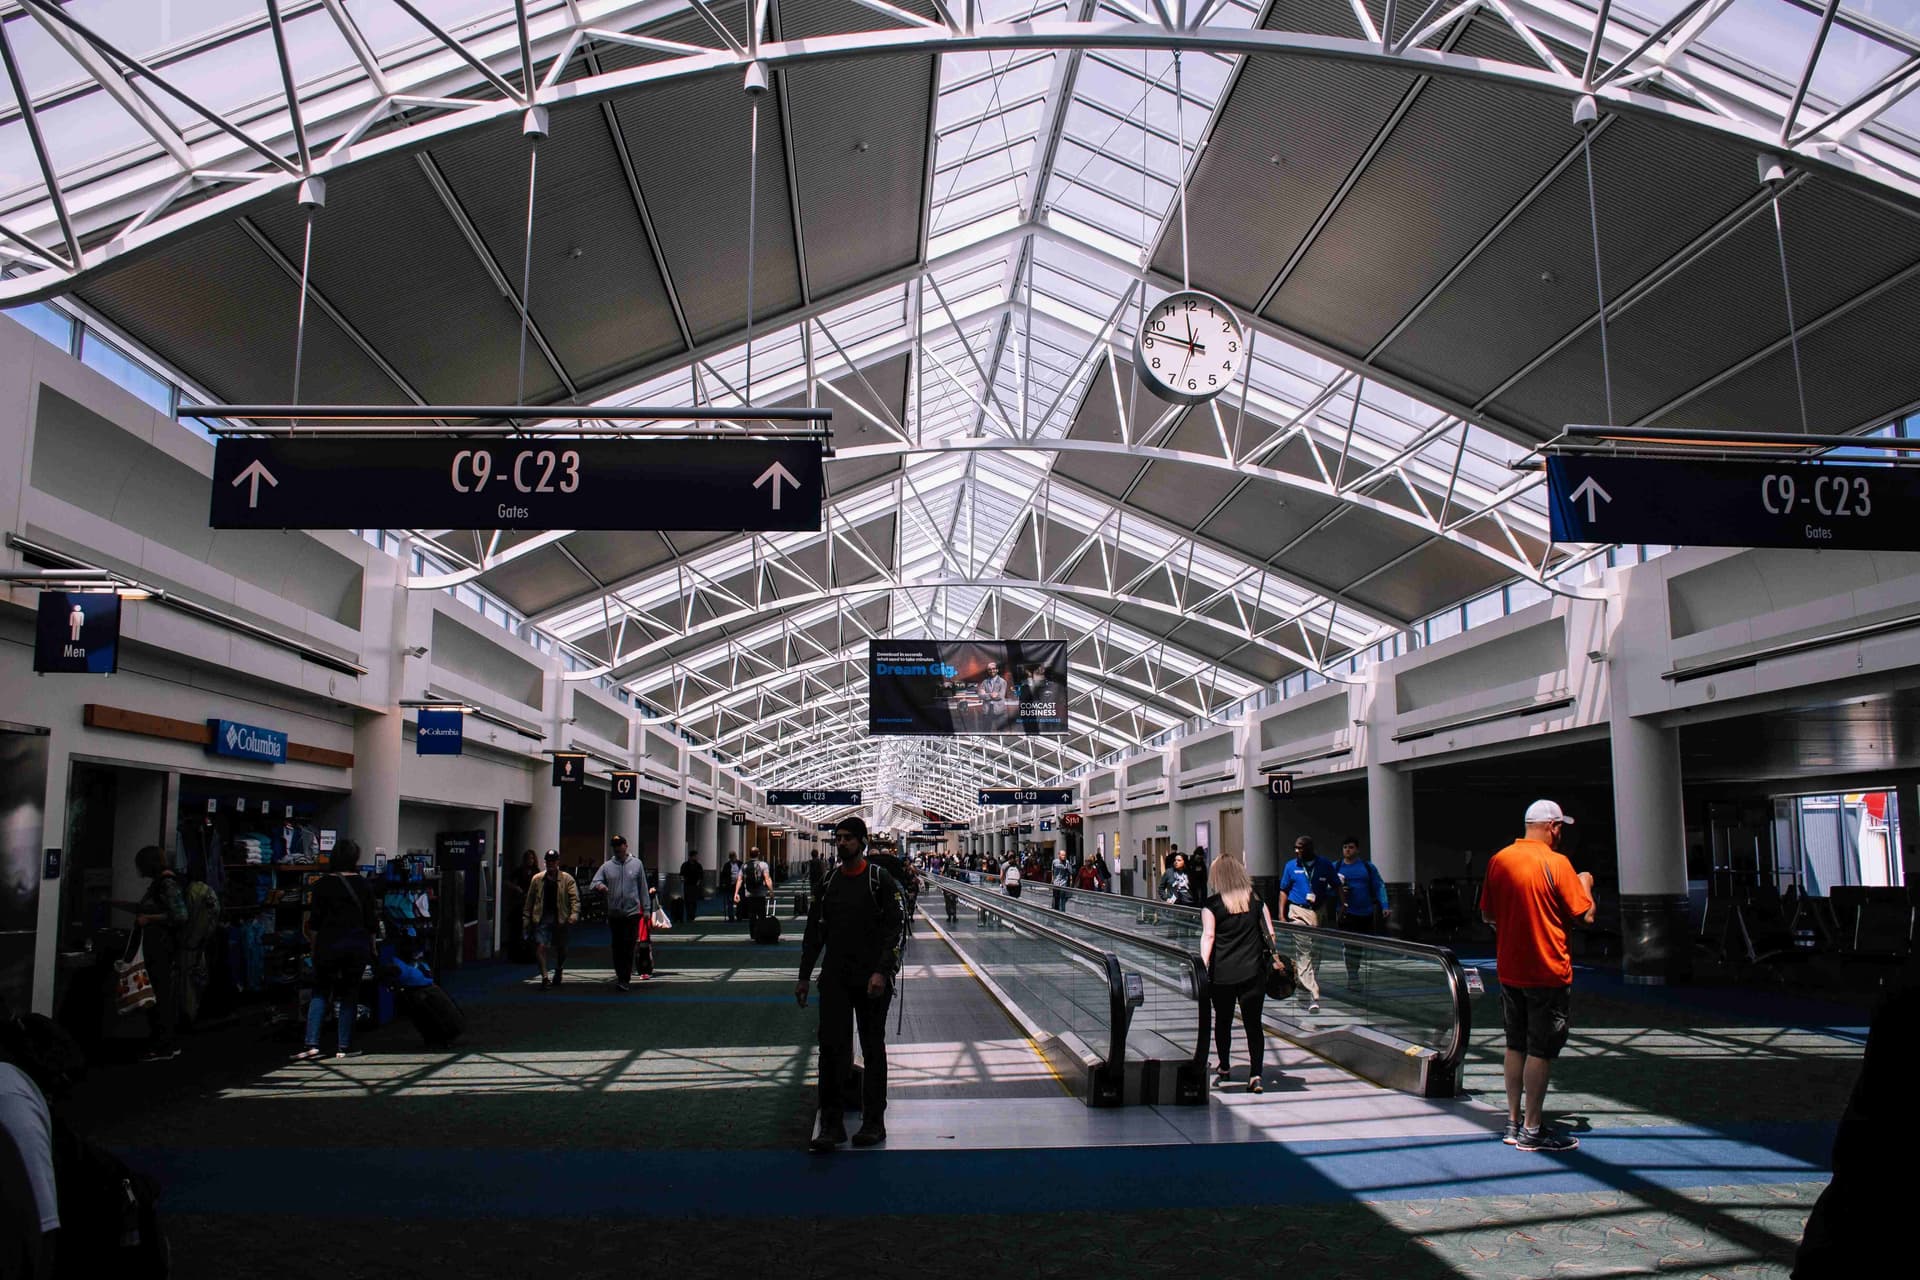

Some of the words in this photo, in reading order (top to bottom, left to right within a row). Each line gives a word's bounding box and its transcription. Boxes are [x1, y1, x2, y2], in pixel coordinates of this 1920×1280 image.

[1164, 306, 1176, 316] 11
[1183, 300, 1197, 312] 12
[1208, 308, 1214, 318] 1
[1150, 320, 1166, 332] 10
[1222, 322, 1231, 332] 2
[1145, 338, 1154, 349] 9
[1228, 342, 1236, 352] 3
[1152, 358, 1160, 368] 8
[1222, 360, 1231, 371] 4
[1168, 374, 1176, 384] 7
[1188, 379, 1196, 390] 6
[1208, 375, 1216, 386] 5
[451, 450, 580, 493] C9-C23
[1762, 474, 1871, 516] C9-C23
[498, 504, 528, 518] Gates
[1806, 524, 1832, 539] Gates
[64, 644, 85, 658] Men
[876, 662, 926, 676] Dream
[929, 662, 958, 679] Gig.
[238, 728, 280, 757] Columbia
[617, 779, 631, 793] C9
[1272, 780, 1290, 794] C10
[802, 792, 826, 800] C11-C23
[1014, 792, 1037, 800] C11-C23
[734, 814, 744, 822] C11
[1065, 815, 1080, 826] Spa
